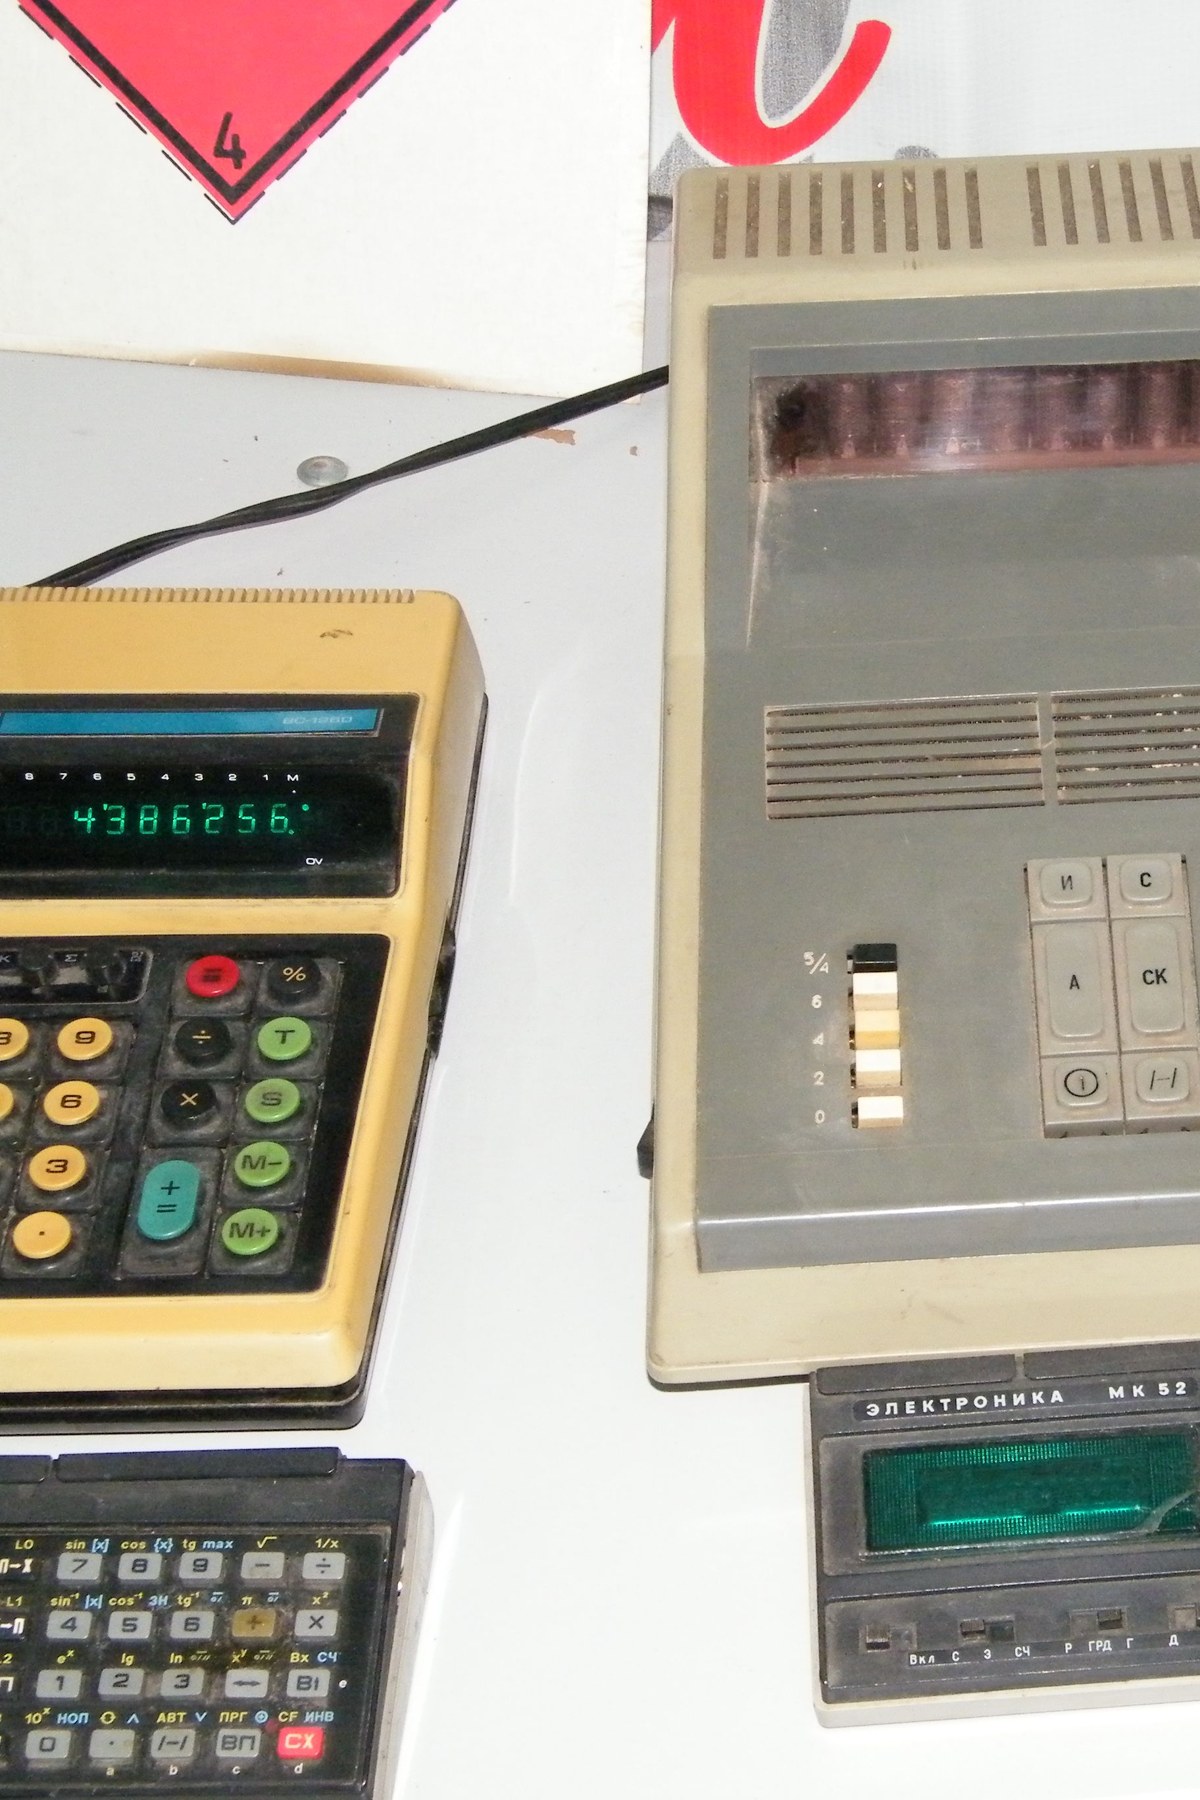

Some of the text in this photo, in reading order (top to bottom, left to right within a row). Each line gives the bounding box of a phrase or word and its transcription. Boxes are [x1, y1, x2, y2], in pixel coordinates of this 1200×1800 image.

[213, 110, 247, 170] 4
[25, 772, 33, 780] 8
[93, 773, 102, 781] 6
[127, 773, 136, 781] 5
[194, 773, 204, 781] 3
[306, 857, 323, 866] OV
[1061, 875, 1073, 891] И
[804, 951, 830, 975] 5/4
[283, 966, 306, 983] %
[811, 994, 822, 1009] 6
[75, 1030, 96, 1045] 9
[274, 1029, 295, 1044] T
[812, 1033, 824, 1046] 4
[814, 1071, 824, 1085] 2
[60, 1094, 82, 1109] 6
[260, 1092, 283, 1107] S
[815, 1110, 825, 1124] 0
[46, 1158, 68, 1174] 3
[229, 1221, 271, 1239] M+
[866, 1381, 1187, 1417] ЭЛЕКТРОНИКА МК 52
[66, 1539, 86, 1550] sin
[121, 1541, 146, 1549] cos
[183, 1539, 234, 1551] tg max
[315, 1538, 339, 1549] 1/x
[72, 1558, 88, 1573] 7
[131, 1558, 148, 1573] 8
[193, 1558, 208, 1573] 9
[6, 1596, 23, 1607] L1
[61, 1617, 77, 1632] 4
[122, 1617, 138, 1632] 5
[184, 1617, 200, 1632] 6
[909, 1654, 935, 1665] Вкл
[1015, 1646, 1031, 1658] СЧ
[1088, 1640, 1112, 1653] ГРД
[1126, 1638, 1134, 1648] Г
[1168, 1635, 1179, 1647] Д
[121, 1653, 134, 1666] lg
[170, 1653, 183, 1664] ln
[56, 1675, 65, 1691] 1
[112, 1673, 129, 1688] 2
[174, 1674, 190, 1689] 3
[57, 1712, 89, 1724] НОП
[156, 1712, 187, 1723] АВТ
[219, 1712, 248, 1722] ПРГ
[304, 1711, 335, 1722] ИНВ
[39, 1737, 56, 1752] 0
[221, 1735, 256, 1750] ВП
[106, 1767, 114, 1776] a
[169, 1765, 178, 1775] b
[232, 1766, 240, 1775] c
[294, 1763, 303, 1774] d
